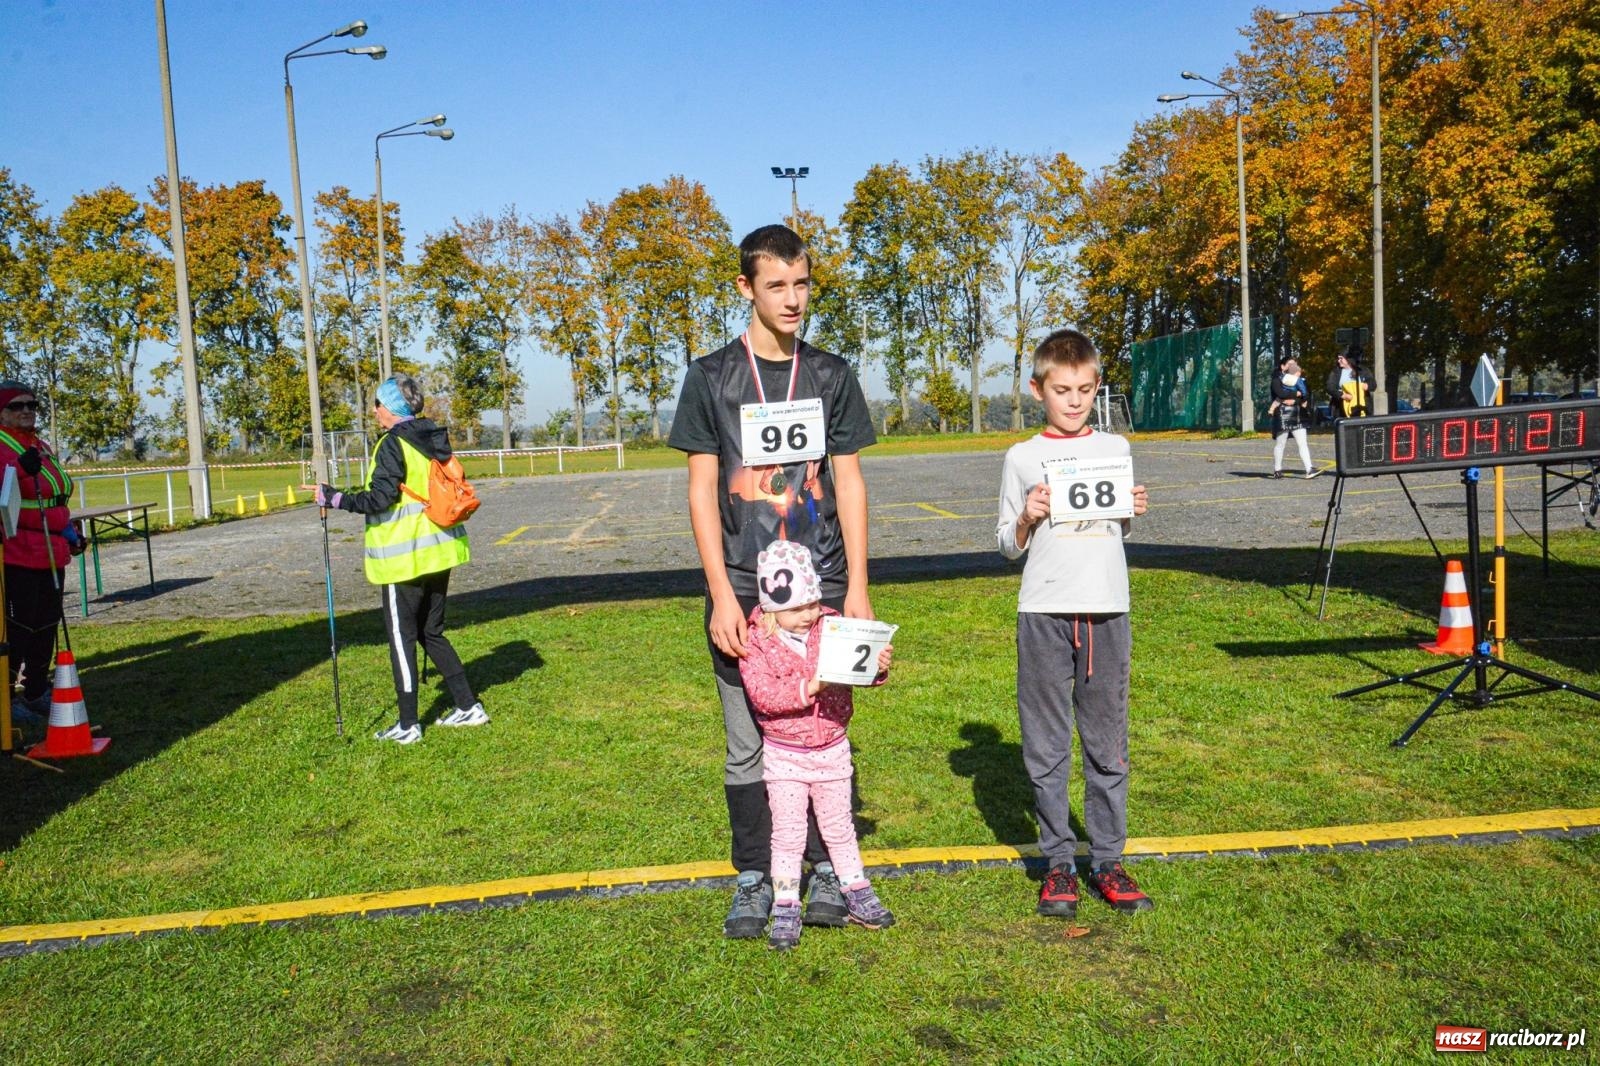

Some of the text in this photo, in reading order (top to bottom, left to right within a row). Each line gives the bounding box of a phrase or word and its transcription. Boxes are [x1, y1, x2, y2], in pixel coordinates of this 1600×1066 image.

[761, 423, 808, 453] 96
[1392, 410, 1585, 462] 0:04:21
[1068, 480, 1116, 510] 68
[851, 644, 871, 673] 2
